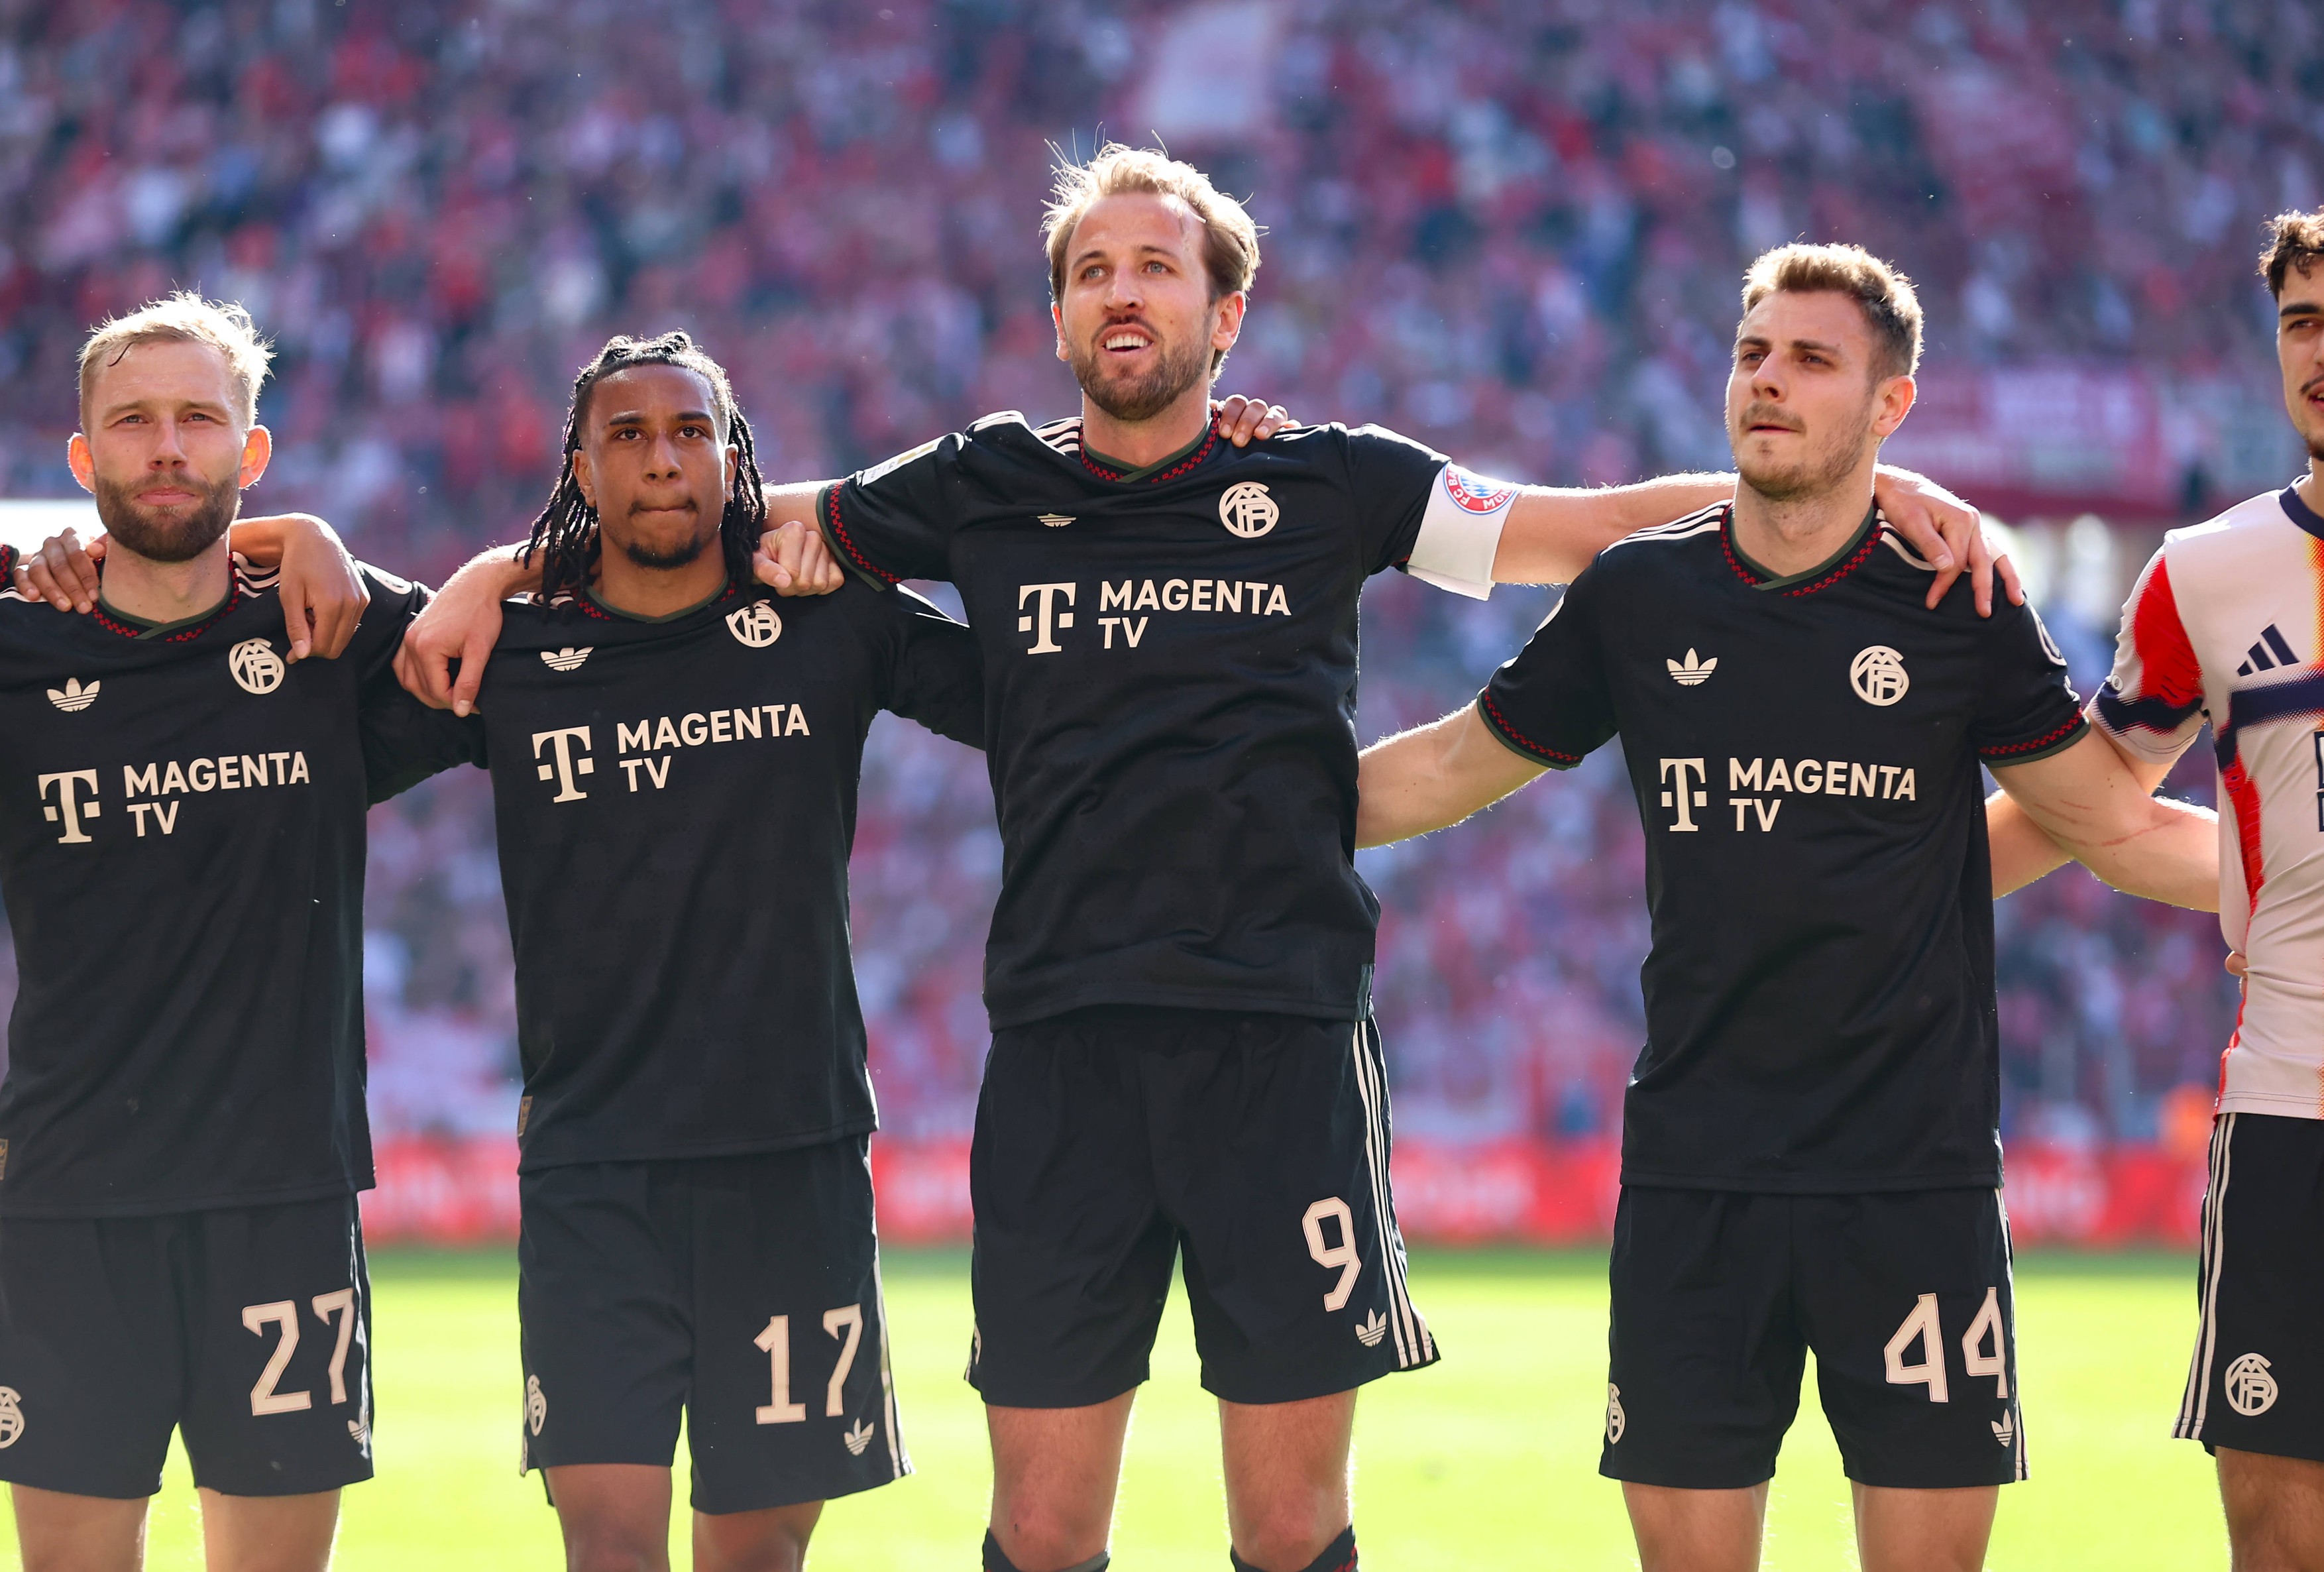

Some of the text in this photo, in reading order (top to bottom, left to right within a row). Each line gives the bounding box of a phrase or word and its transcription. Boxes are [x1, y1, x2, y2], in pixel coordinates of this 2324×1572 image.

[1453, 488, 1471, 506] FC
[1099, 579, 1292, 616] MAGENTA
[1097, 616, 1148, 649] TV
[617, 703, 810, 754] MAGENTA
[123, 751, 310, 798] MAGENTA
[619, 755, 671, 793] TV
[1729, 758, 1916, 801] MAGENTA
[127, 800, 180, 837] TV
[1729, 798, 1782, 832] TV
[1301, 1196, 1362, 1312] 9
[241, 1288, 355, 1416] 27
[753, 1303, 863, 1425] 17
[1883, 1286, 2009, 1404] 44
